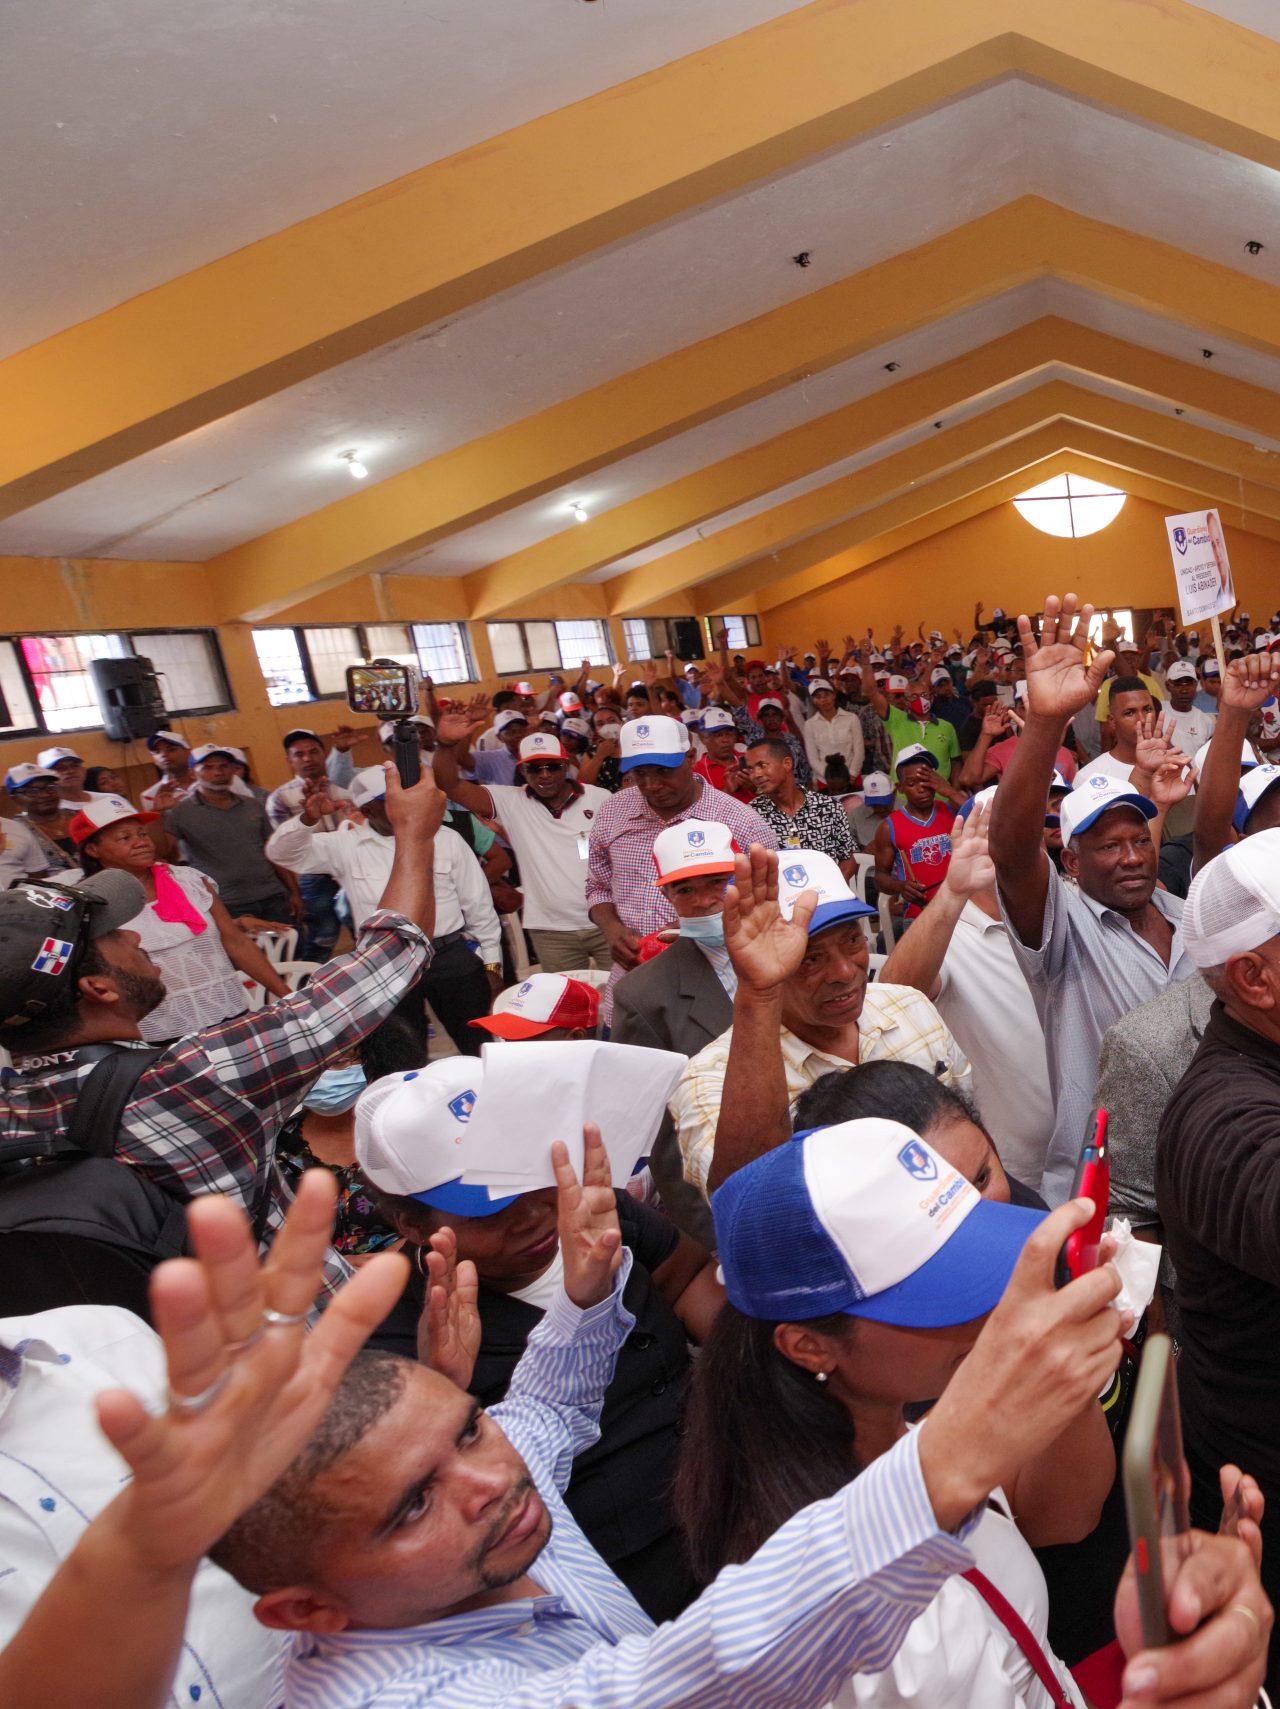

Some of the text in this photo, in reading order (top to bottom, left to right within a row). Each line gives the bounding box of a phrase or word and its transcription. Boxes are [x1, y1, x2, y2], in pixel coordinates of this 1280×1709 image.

[1185, 577, 1217, 595] LUIS ABINADER
[21, 1049, 80, 1070] SONY
[928, 1202, 941, 1218] del
